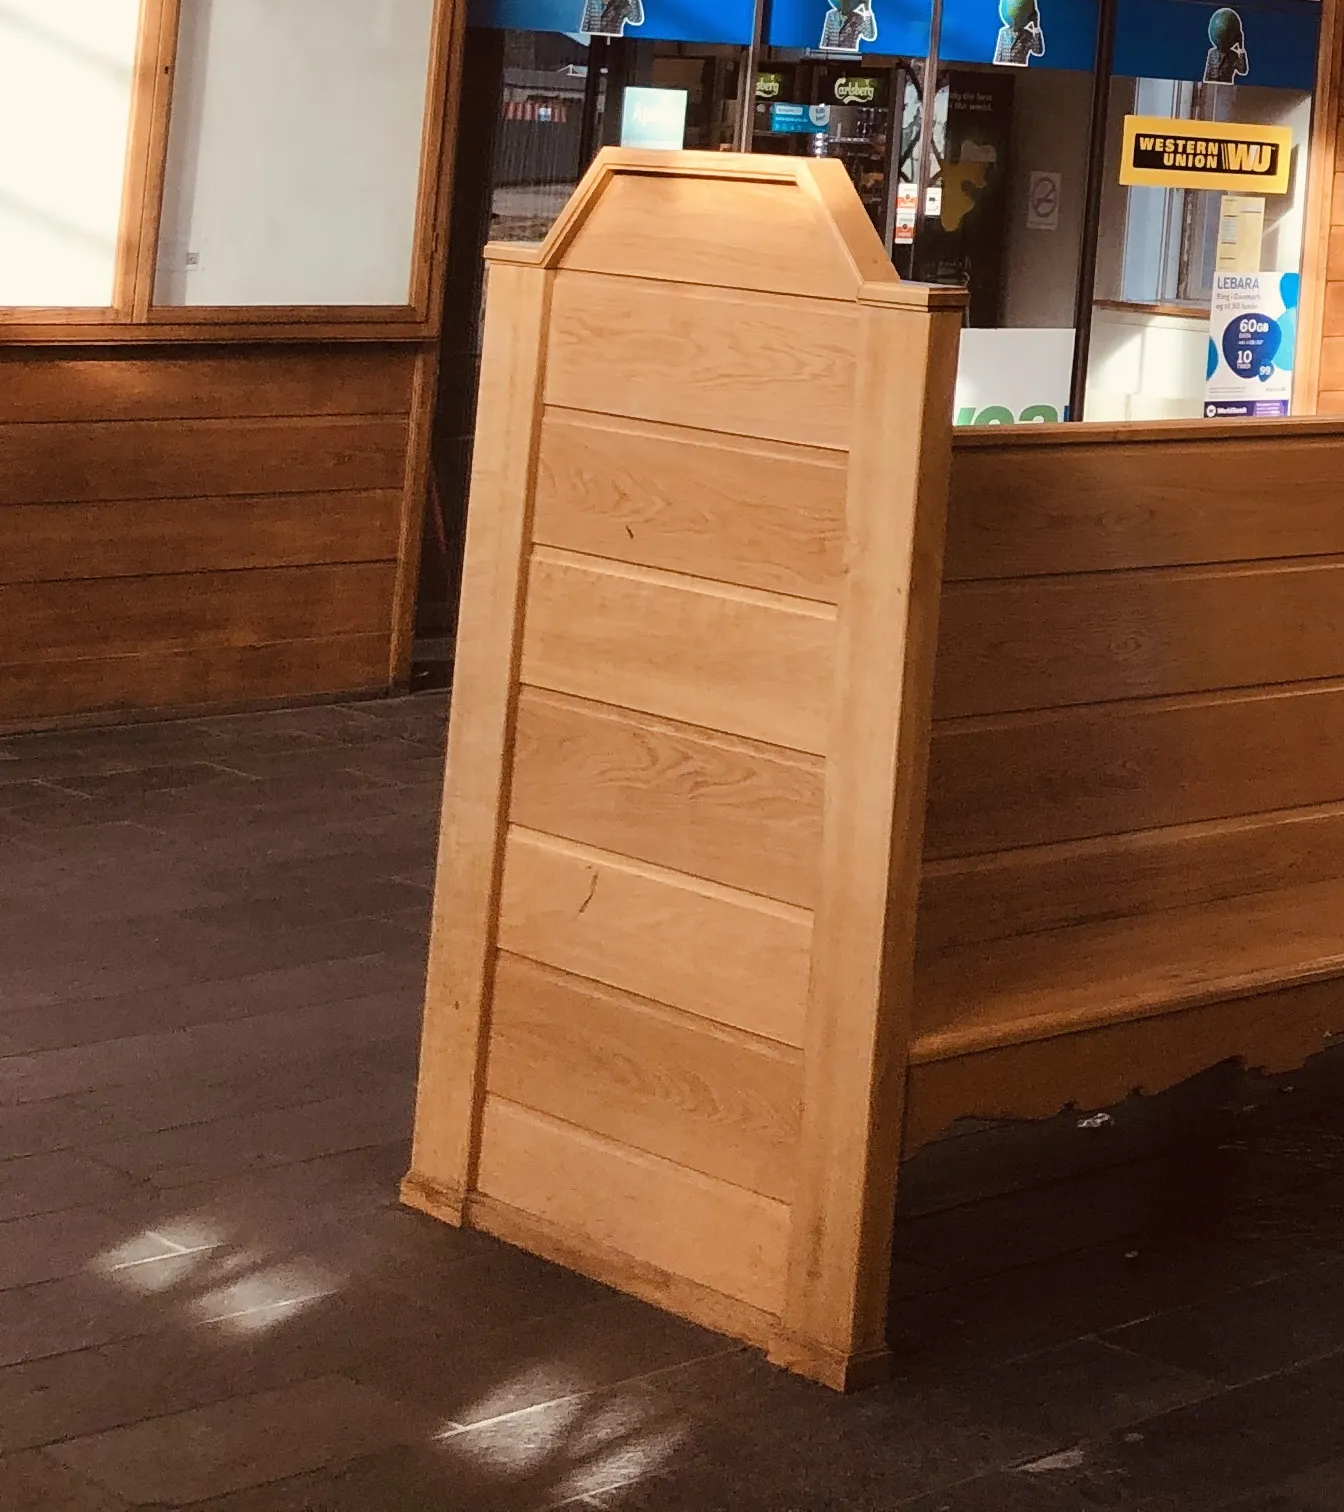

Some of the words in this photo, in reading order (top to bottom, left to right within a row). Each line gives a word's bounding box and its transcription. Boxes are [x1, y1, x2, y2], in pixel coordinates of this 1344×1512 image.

[835, 76, 875, 105] Carlsberg
[1139, 137, 1219, 155] WESTERN
[1163, 153, 1218, 169] UNION
[1217, 276, 1260, 290] LEBARA
[1237, 350, 1253, 364] 10
[1260, 365, 1271, 376] 99
